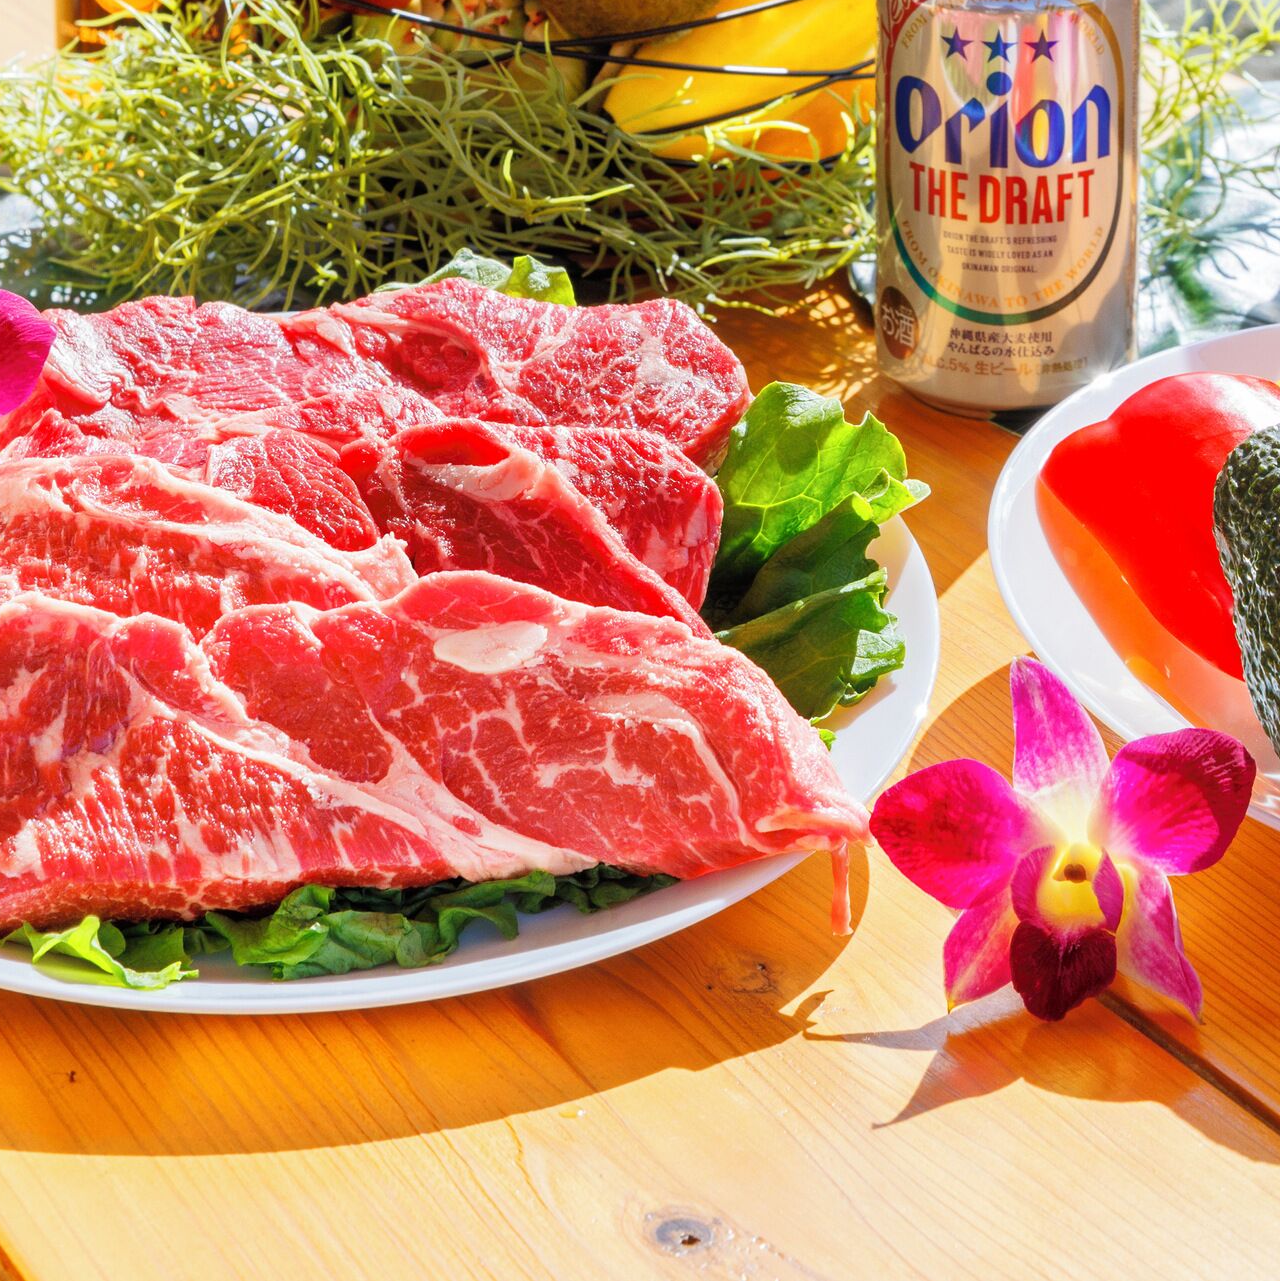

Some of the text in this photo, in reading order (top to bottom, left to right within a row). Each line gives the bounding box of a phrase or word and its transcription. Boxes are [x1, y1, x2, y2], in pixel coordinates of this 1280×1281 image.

[900, 13, 928, 49] FROM
[894, 70, 1112, 169] Orion
[909, 161, 1095, 226] THE DRAFT
[980, 234, 1012, 246] DRAFT'S
[1013, 234, 1058, 246] REFRESHING
[902, 220, 1104, 309] FROM OKINAWA TO THE WORLD
[1007, 249, 1031, 260] LOVED
[1032, 249, 1042, 259] AS
[1043, 248, 1054, 258] AN
[949, 327, 1054, 345] 沖縄県産大麦使用
[946, 342, 1056, 359] やんばるの水仕込み
